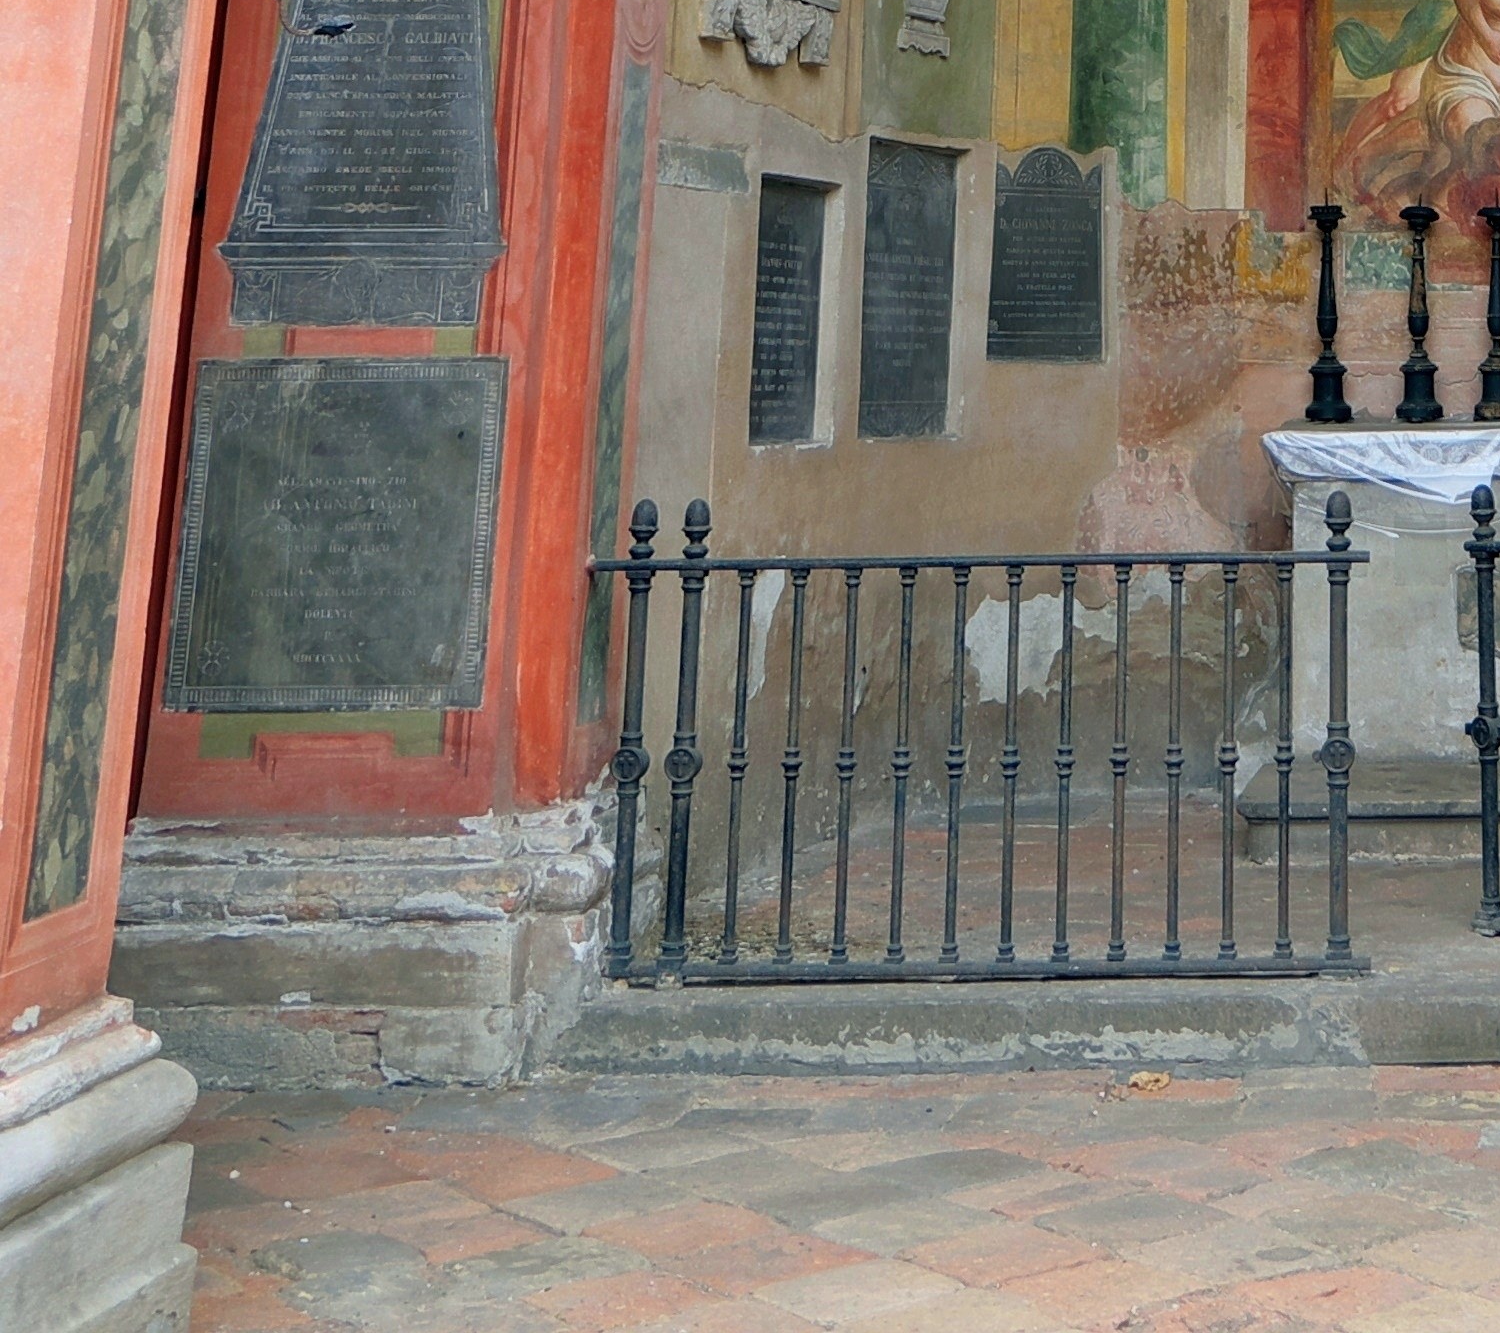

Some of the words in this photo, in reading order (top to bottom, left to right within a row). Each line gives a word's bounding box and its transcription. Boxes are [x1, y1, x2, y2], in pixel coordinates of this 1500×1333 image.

[311, 33, 395, 45] FRANCESCO
[404, 33, 475, 45] GALBIATI
[364, 185, 401, 193] DELLE
[1011, 217, 1056, 231] GIOVANNI
